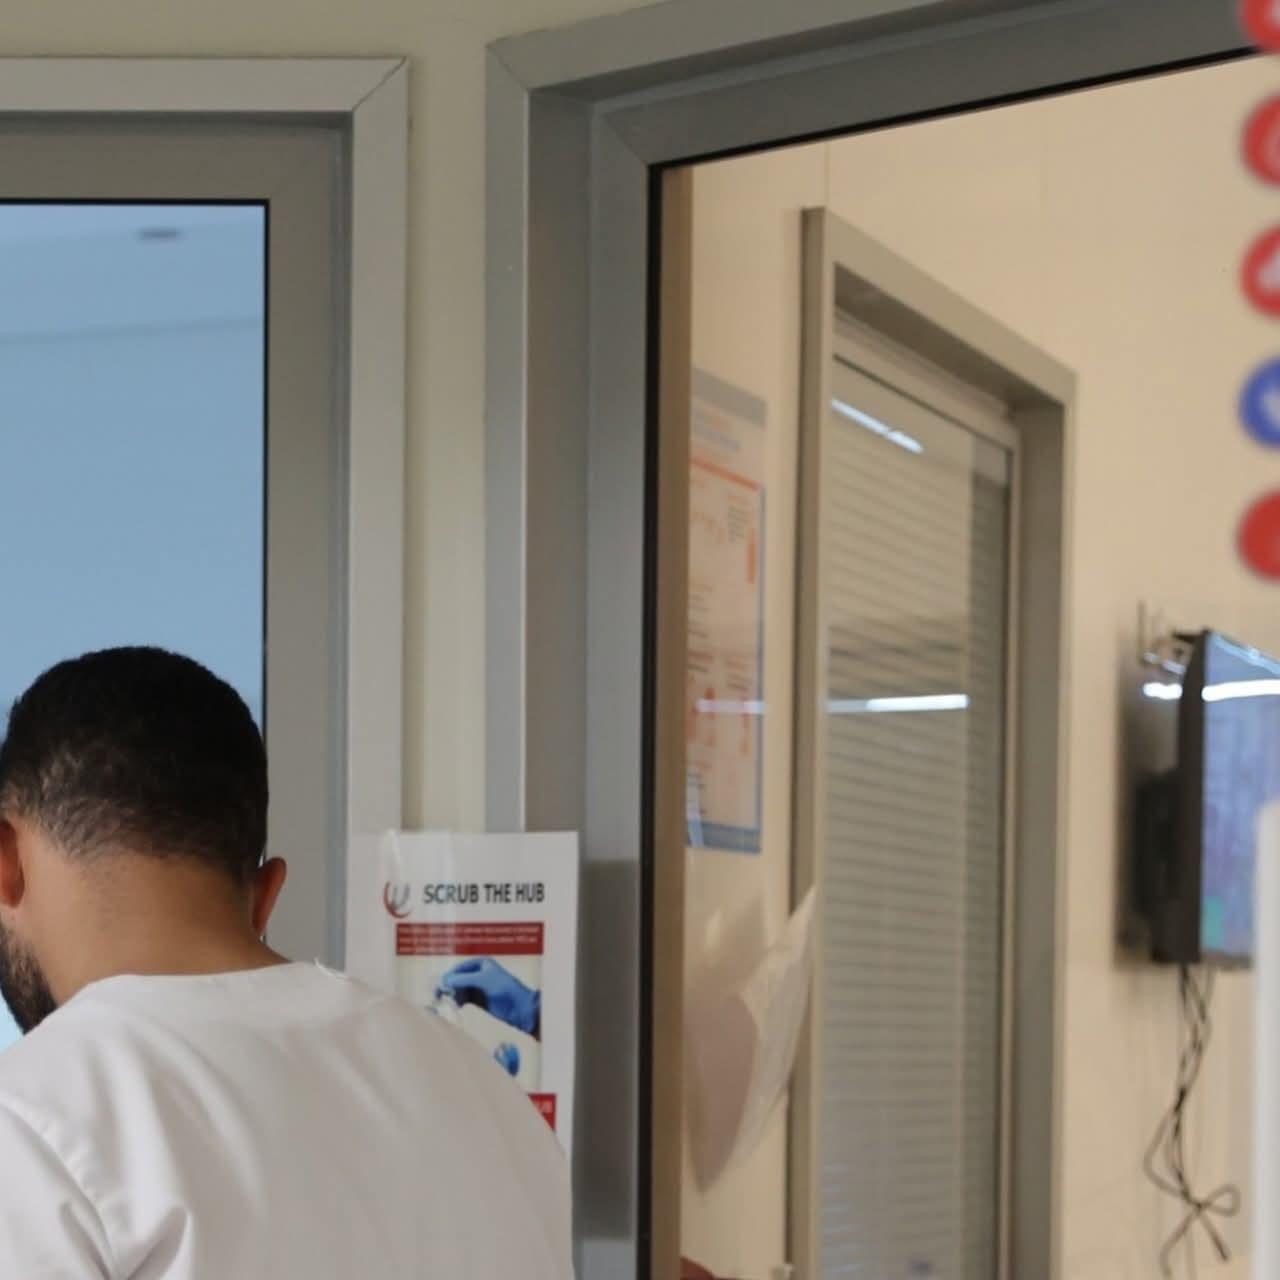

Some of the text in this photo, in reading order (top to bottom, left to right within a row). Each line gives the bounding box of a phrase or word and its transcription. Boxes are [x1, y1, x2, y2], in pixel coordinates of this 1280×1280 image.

[423, 882, 545, 904] SCRUB THE HUB
